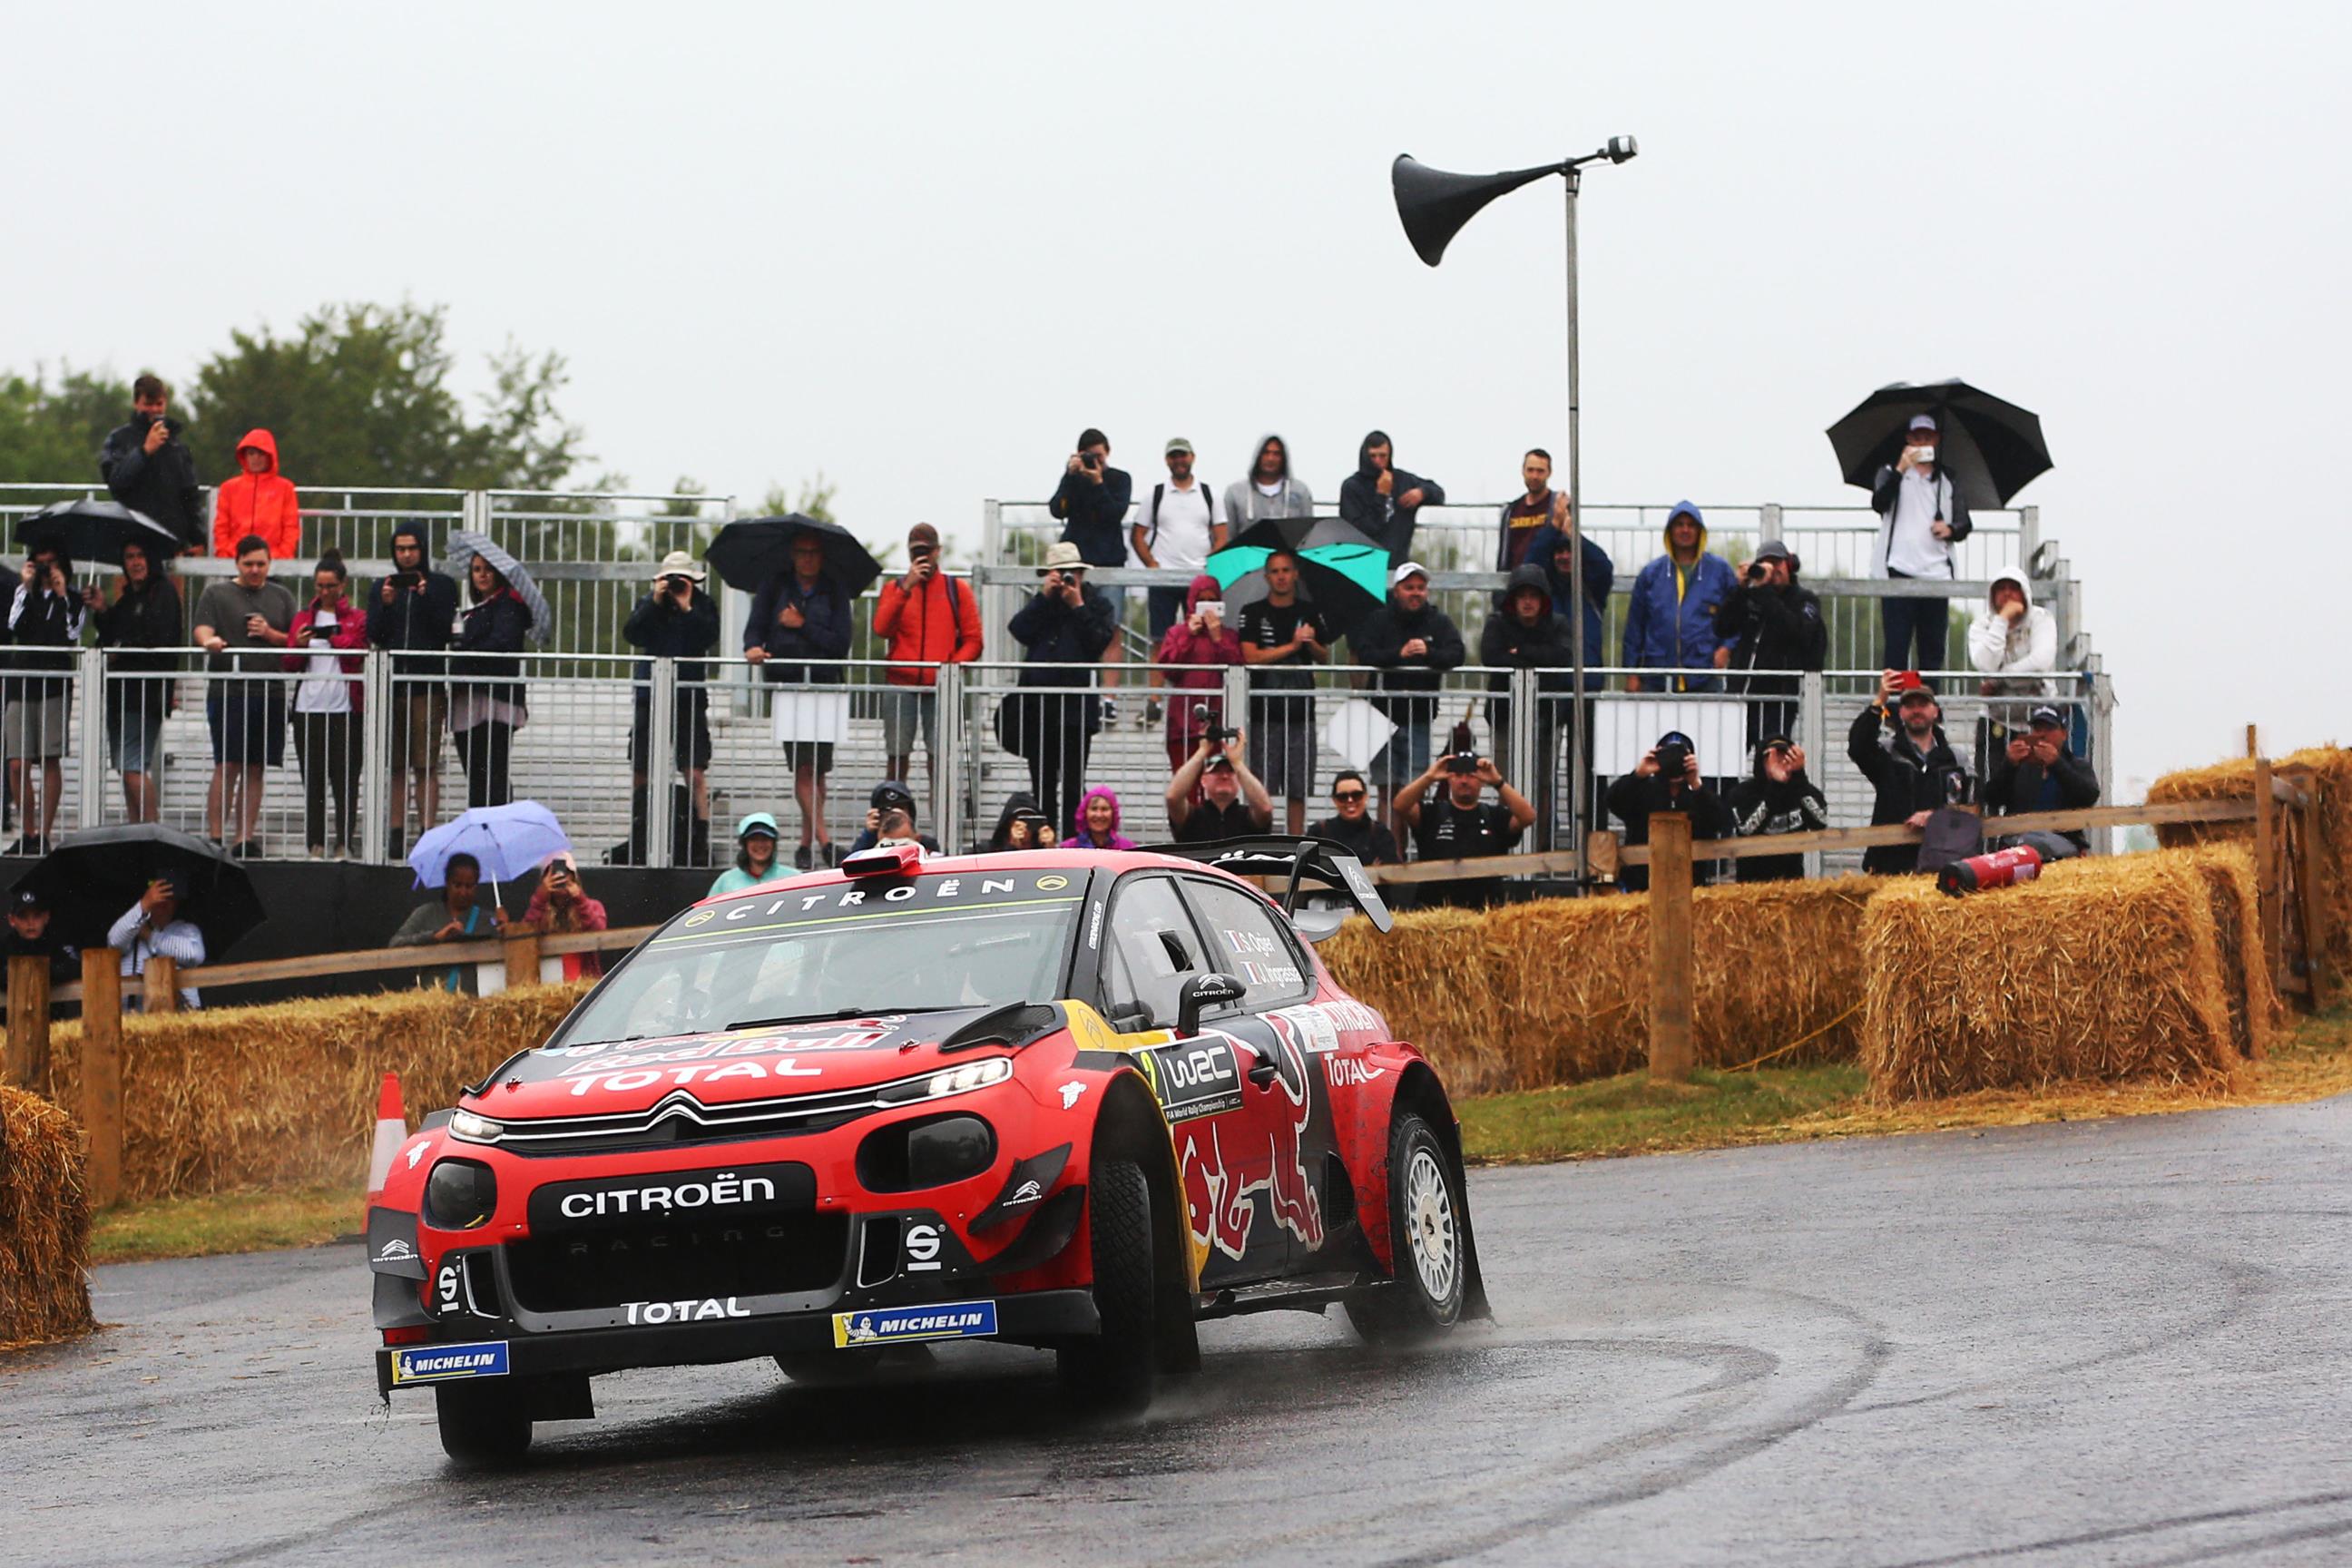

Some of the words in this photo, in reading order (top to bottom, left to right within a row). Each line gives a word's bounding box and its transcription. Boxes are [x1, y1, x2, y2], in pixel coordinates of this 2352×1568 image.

[726, 878, 1014, 921] CITROËN
[1248, 931, 1276, 957] Ogier
[557, 1041, 731, 1077] Red
[715, 1031, 894, 1057] Bull
[1165, 1045, 1232, 1088] WRC
[1324, 1053, 1386, 1087] TOTAL
[565, 1058, 822, 1096] TOTAL
[1166, 1111, 1175, 1121] FIA
[1174, 1105, 1189, 1119] World
[1188, 1104, 1200, 1116] Rally
[1198, 1099, 1226, 1113] Championship
[561, 1172, 776, 1218] CITROËN
[620, 1297, 751, 1326] TOTAL
[879, 1313, 983, 1334] MICHELIN
[416, 1353, 495, 1372] MICHELIN
